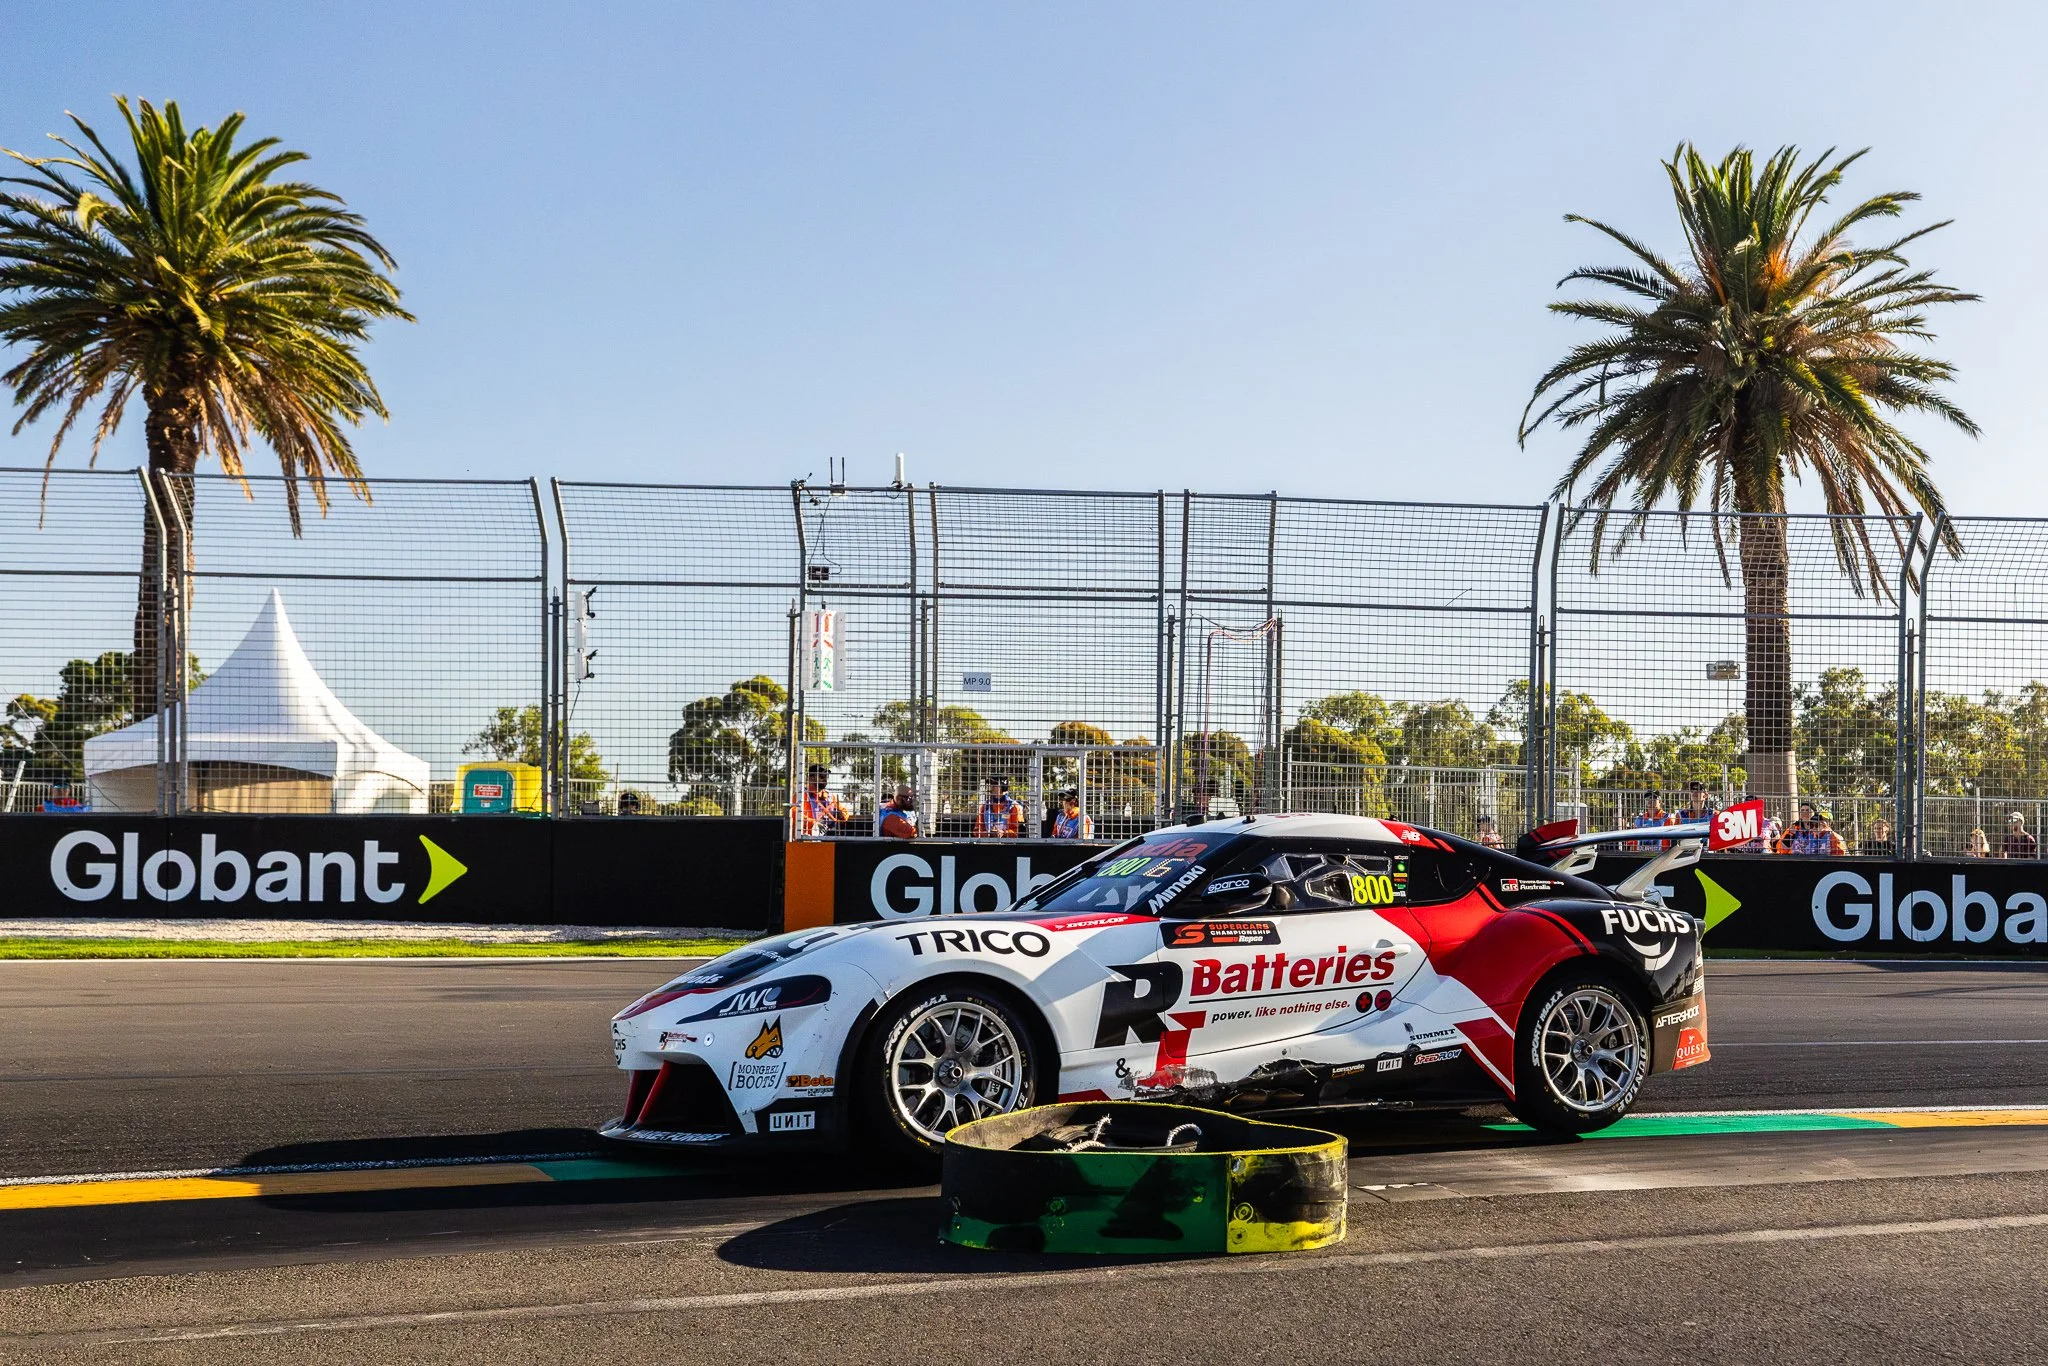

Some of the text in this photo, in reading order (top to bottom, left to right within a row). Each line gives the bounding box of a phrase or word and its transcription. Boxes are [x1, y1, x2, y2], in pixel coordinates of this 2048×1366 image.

[1718, 809, 1757, 841] 3M
[50, 829, 406, 904] Globant
[1097, 857, 1151, 877] 800
[1207, 879, 1250, 892] sparco
[1352, 875, 1394, 904] 800
[1064, 916, 1129, 928] DUNLOP
[1600, 909, 1690, 935] FUCHS
[895, 930, 1051, 957] TRICO
[1238, 935, 1264, 943] Repco
[1190, 945, 1396, 997] Batteries
[1211, 999, 1350, 1023] power. like nothing else.
[1409, 1028, 1456, 1041] SUMMIT
[1531, 990, 1564, 1067] SPORT MAXX
[1677, 1042, 1706, 1060] QUEST
[738, 1064, 779, 1074] MONGREL
[1332, 1063, 1365, 1074] Lansvale
[735, 1074, 777, 1089] BOOTS
[800, 1074, 834, 1087] Beta
[1617, 1046, 1646, 1113] DUNLOP
